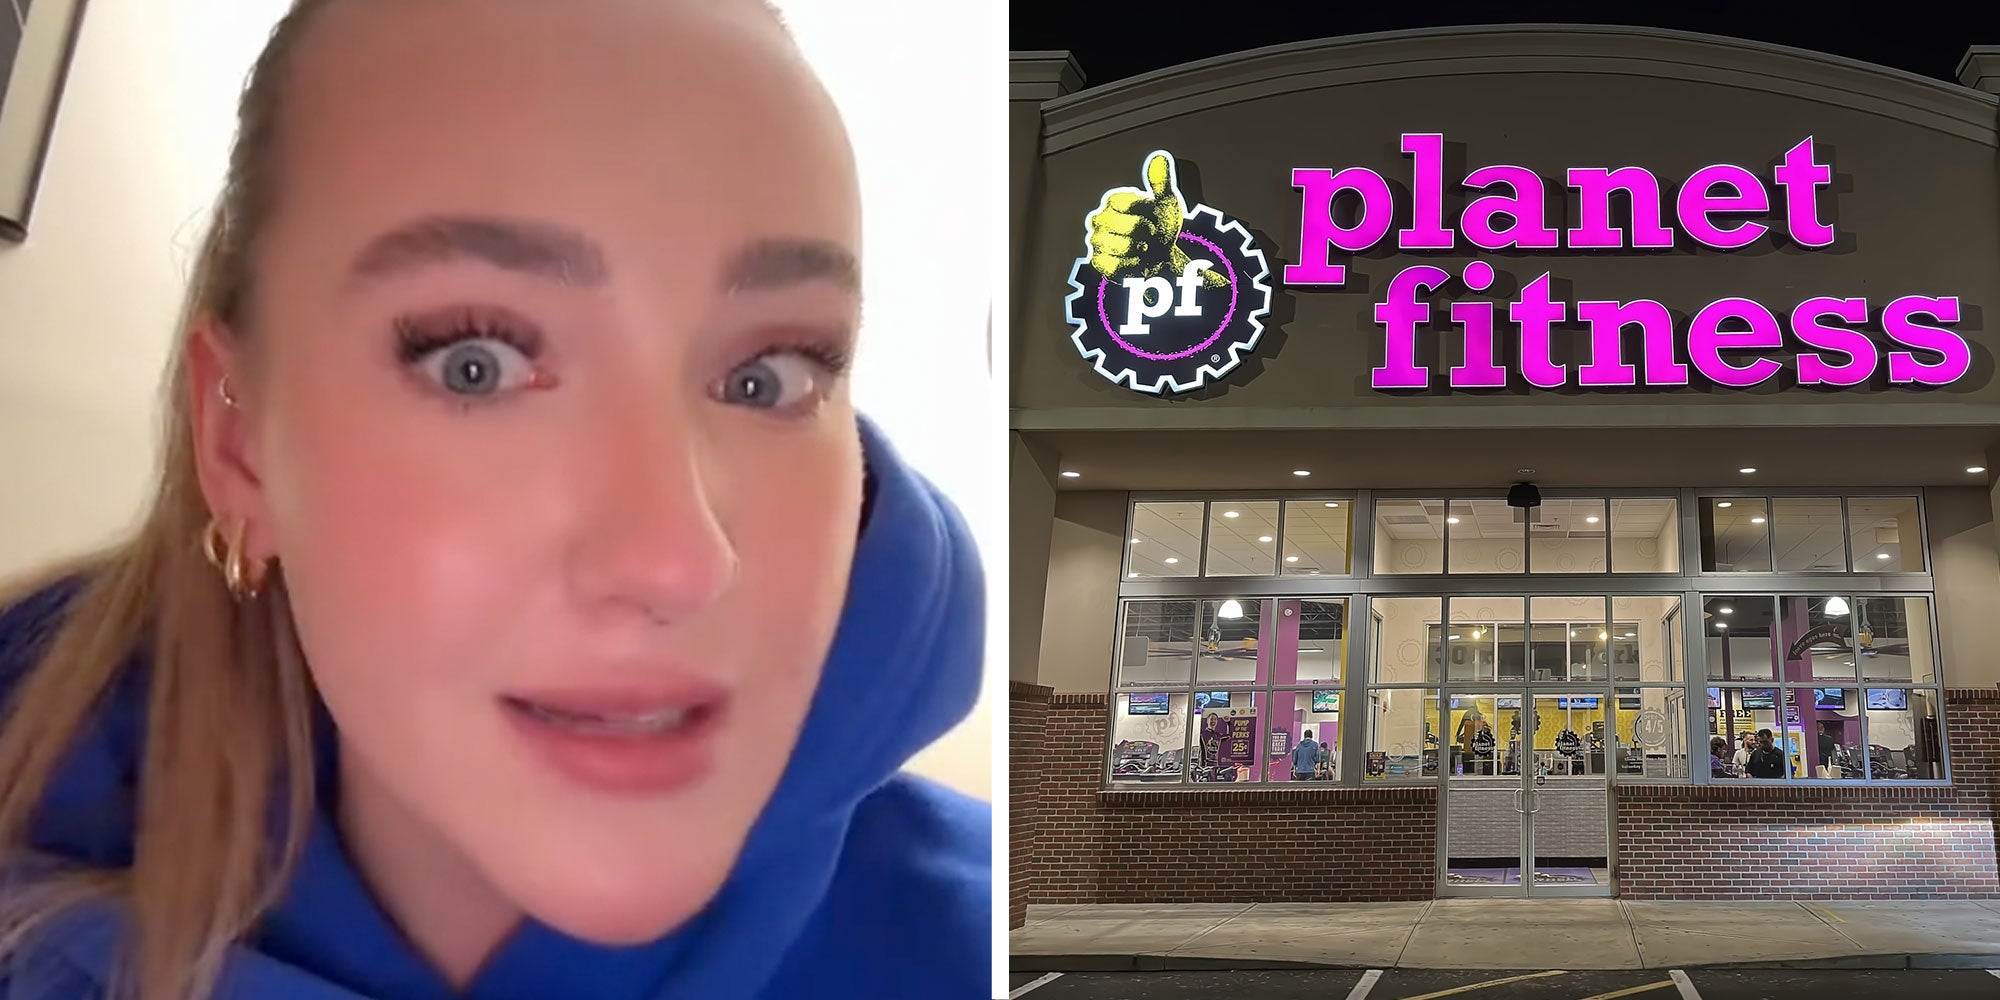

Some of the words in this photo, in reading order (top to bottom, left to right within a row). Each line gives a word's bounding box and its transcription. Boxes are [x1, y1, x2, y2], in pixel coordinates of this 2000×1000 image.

[1284, 133, 1834, 286] planet
[1120, 259, 1214, 335] pf
[1371, 261, 1972, 388] fitness
[1720, 710, 1751, 718] FEE
